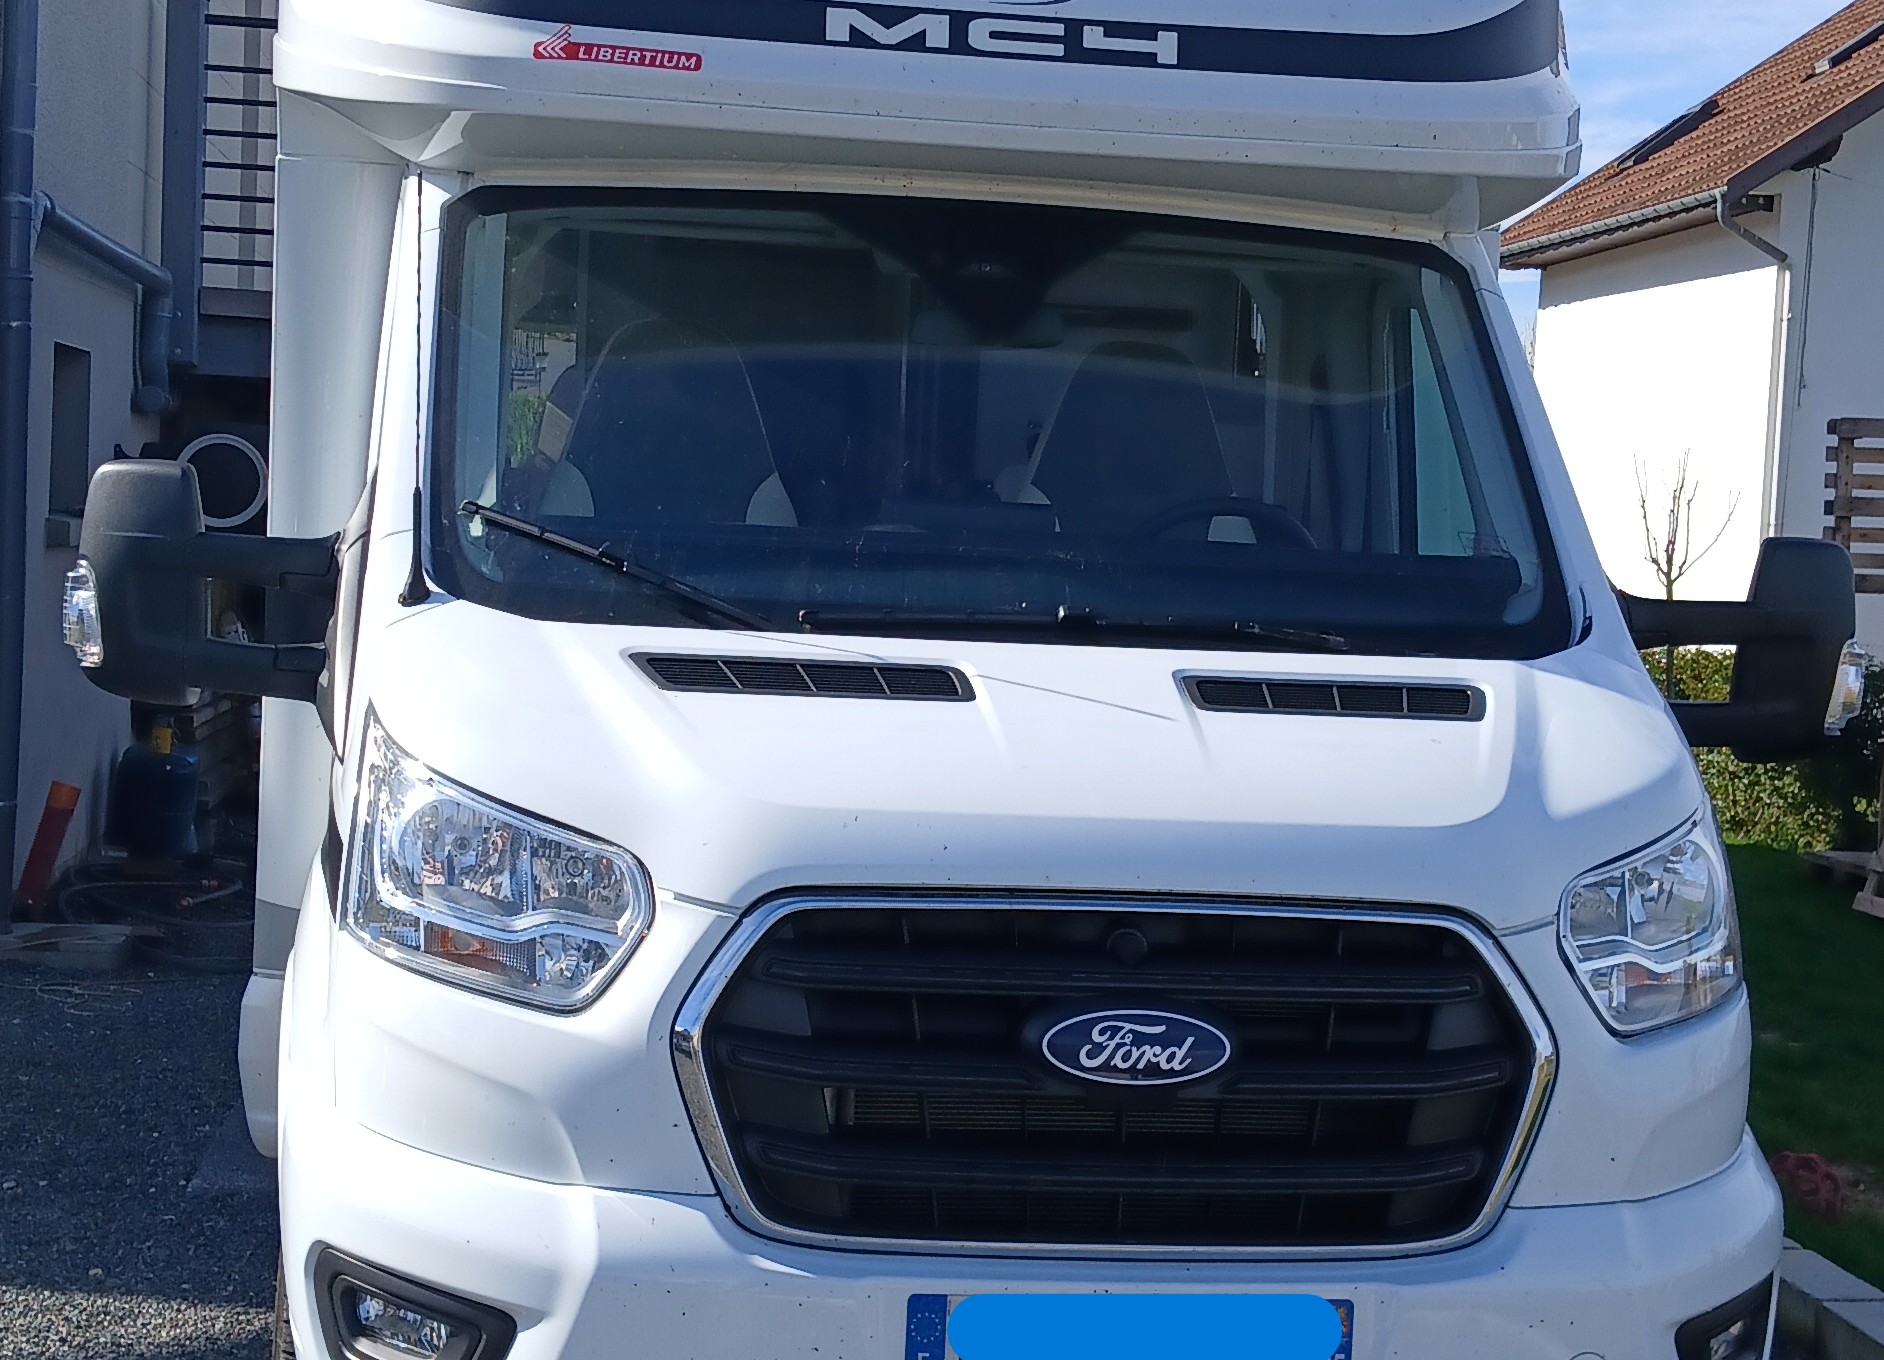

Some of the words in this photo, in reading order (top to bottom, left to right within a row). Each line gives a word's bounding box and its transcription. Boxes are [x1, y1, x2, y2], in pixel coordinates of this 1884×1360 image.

[577, 45, 698, 69] LIBERTIUM
[825, 6, 1179, 65] MC4
[1079, 1021, 1196, 1071] Ford
